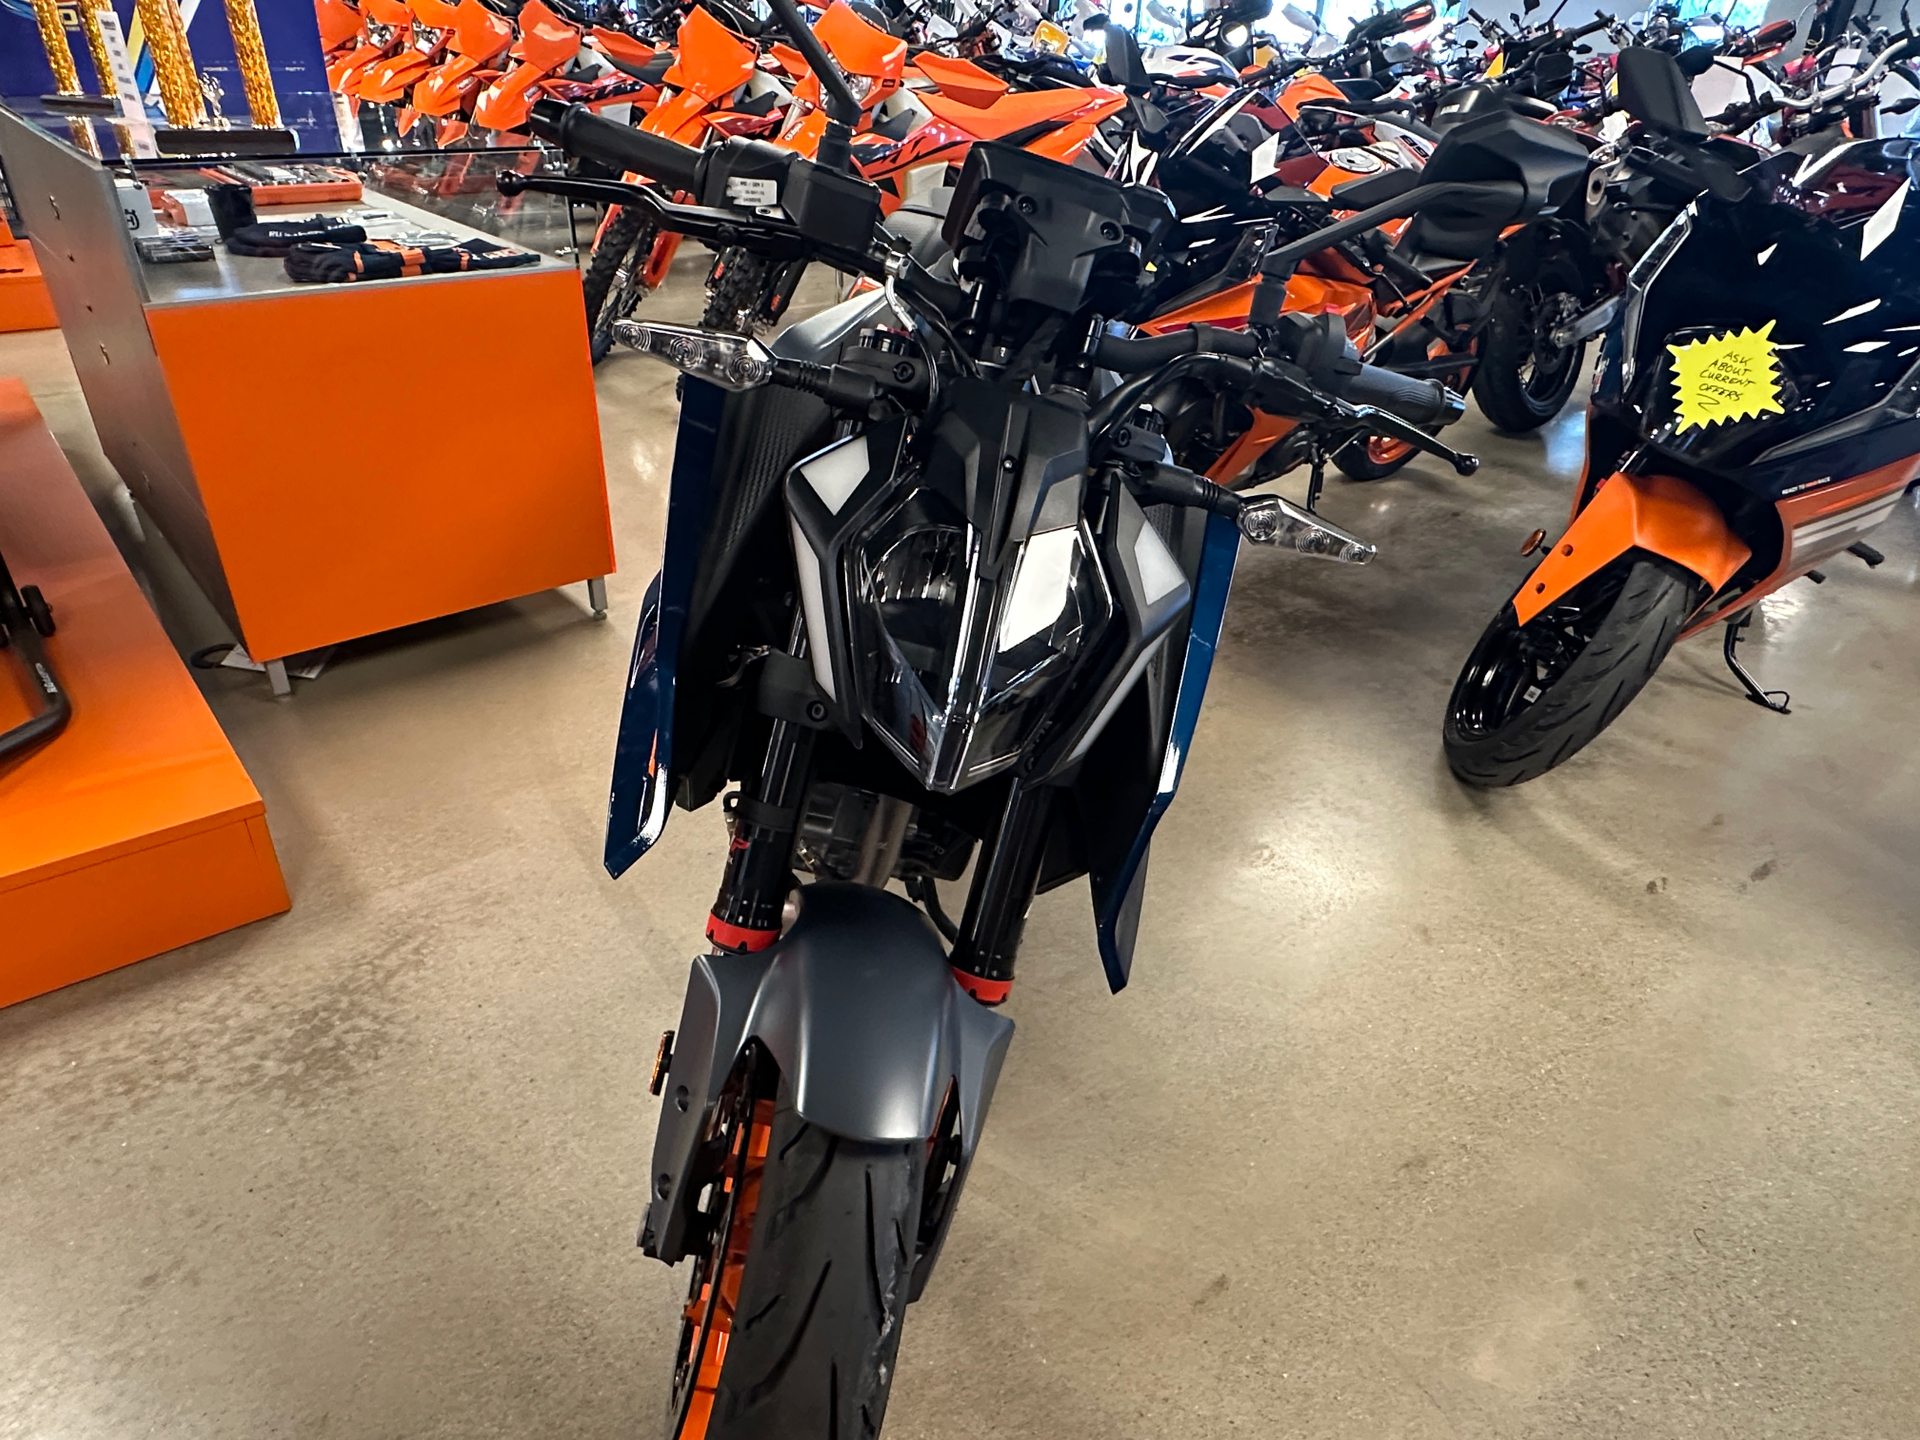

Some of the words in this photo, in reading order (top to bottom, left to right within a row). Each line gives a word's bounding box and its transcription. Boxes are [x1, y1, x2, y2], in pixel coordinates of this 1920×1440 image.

[1723, 351, 1753, 366] ASK
[1708, 359, 1752, 376] ABOUT
[1700, 369, 1756, 387] CURRENT
[1699, 383, 1743, 401] OFFERS
